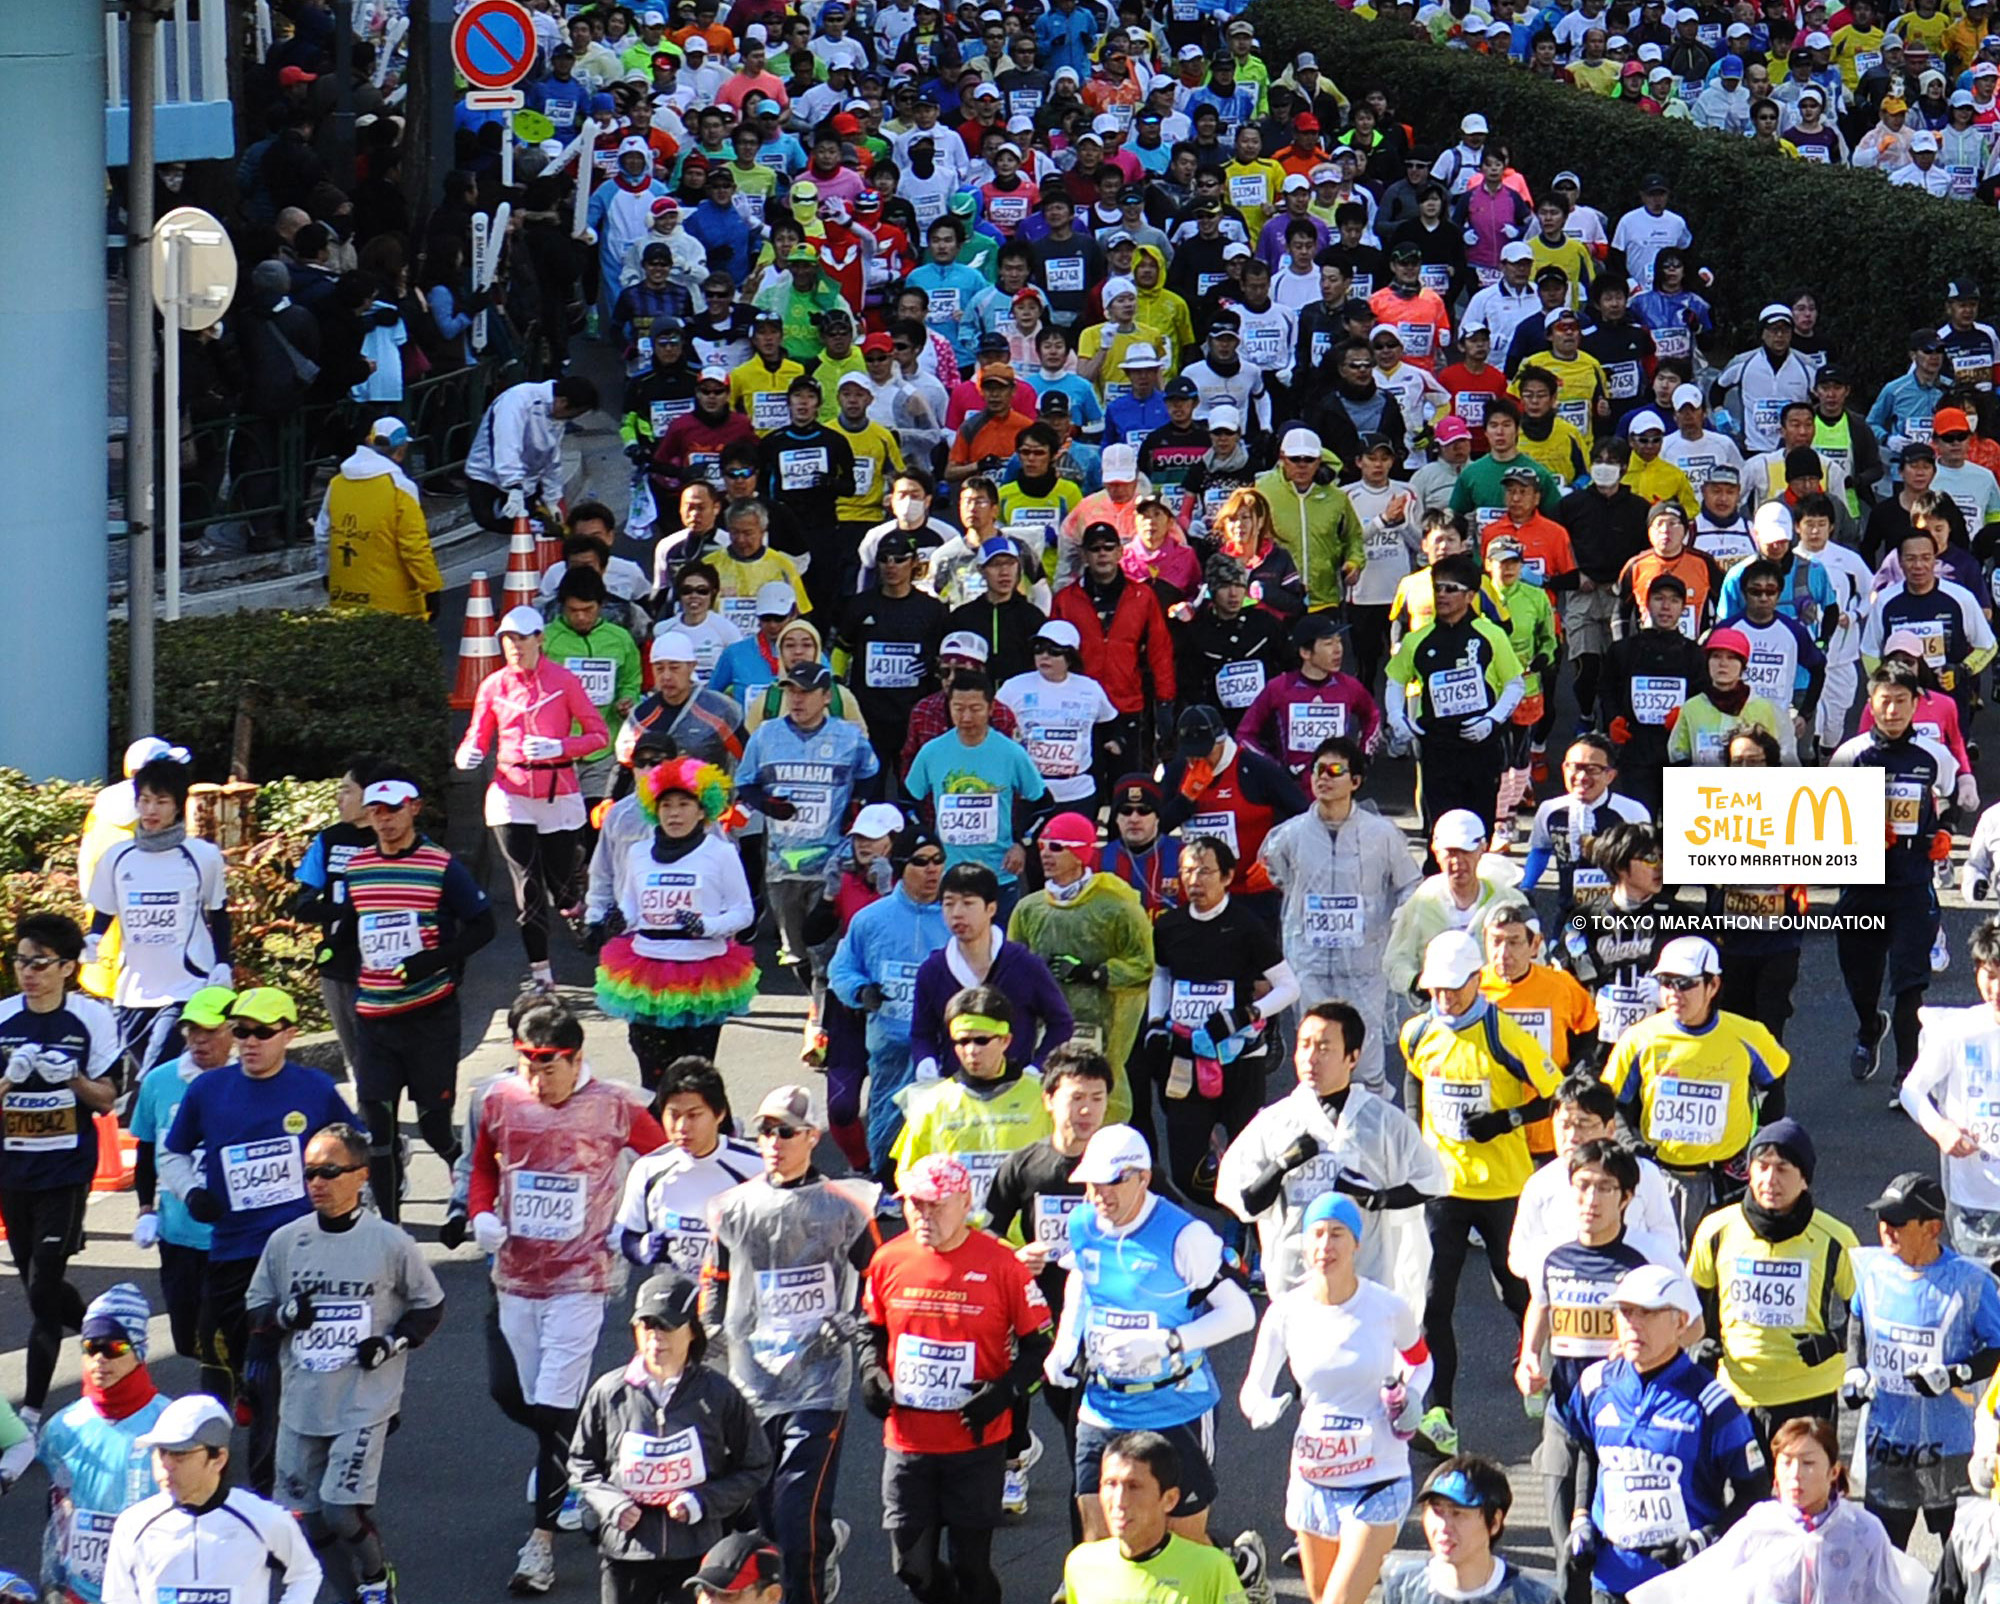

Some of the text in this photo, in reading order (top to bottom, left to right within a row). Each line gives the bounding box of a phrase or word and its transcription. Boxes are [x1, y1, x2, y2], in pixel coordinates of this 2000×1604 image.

[869, 658, 911, 674] J43112
[1434, 681, 1478, 704] H37699
[1634, 693, 1676, 709] G33522
[1291, 721, 1336, 737] H38259
[1028, 742, 1074, 761] H52762
[776, 766, 833, 783] YAMAHA
[941, 812, 987, 830] G34281
[125, 910, 175, 928] G33468
[1306, 912, 1354, 932] H38304
[362, 932, 411, 953] G34774
[6, 1095, 60, 1107] XEBIO
[1655, 1100, 1716, 1126] G34510
[230, 1161, 291, 1190] G36404
[514, 1194, 573, 1220] G37048
[289, 1279, 375, 1297] ATHLETA
[1731, 1280, 1795, 1306] G34696
[1552, 1310, 1614, 1334] G71013
[294, 1326, 358, 1352] H38048
[898, 1362, 960, 1390] G35547
[1298, 1435, 1357, 1460] G52541
[624, 1458, 692, 1484] H52959
